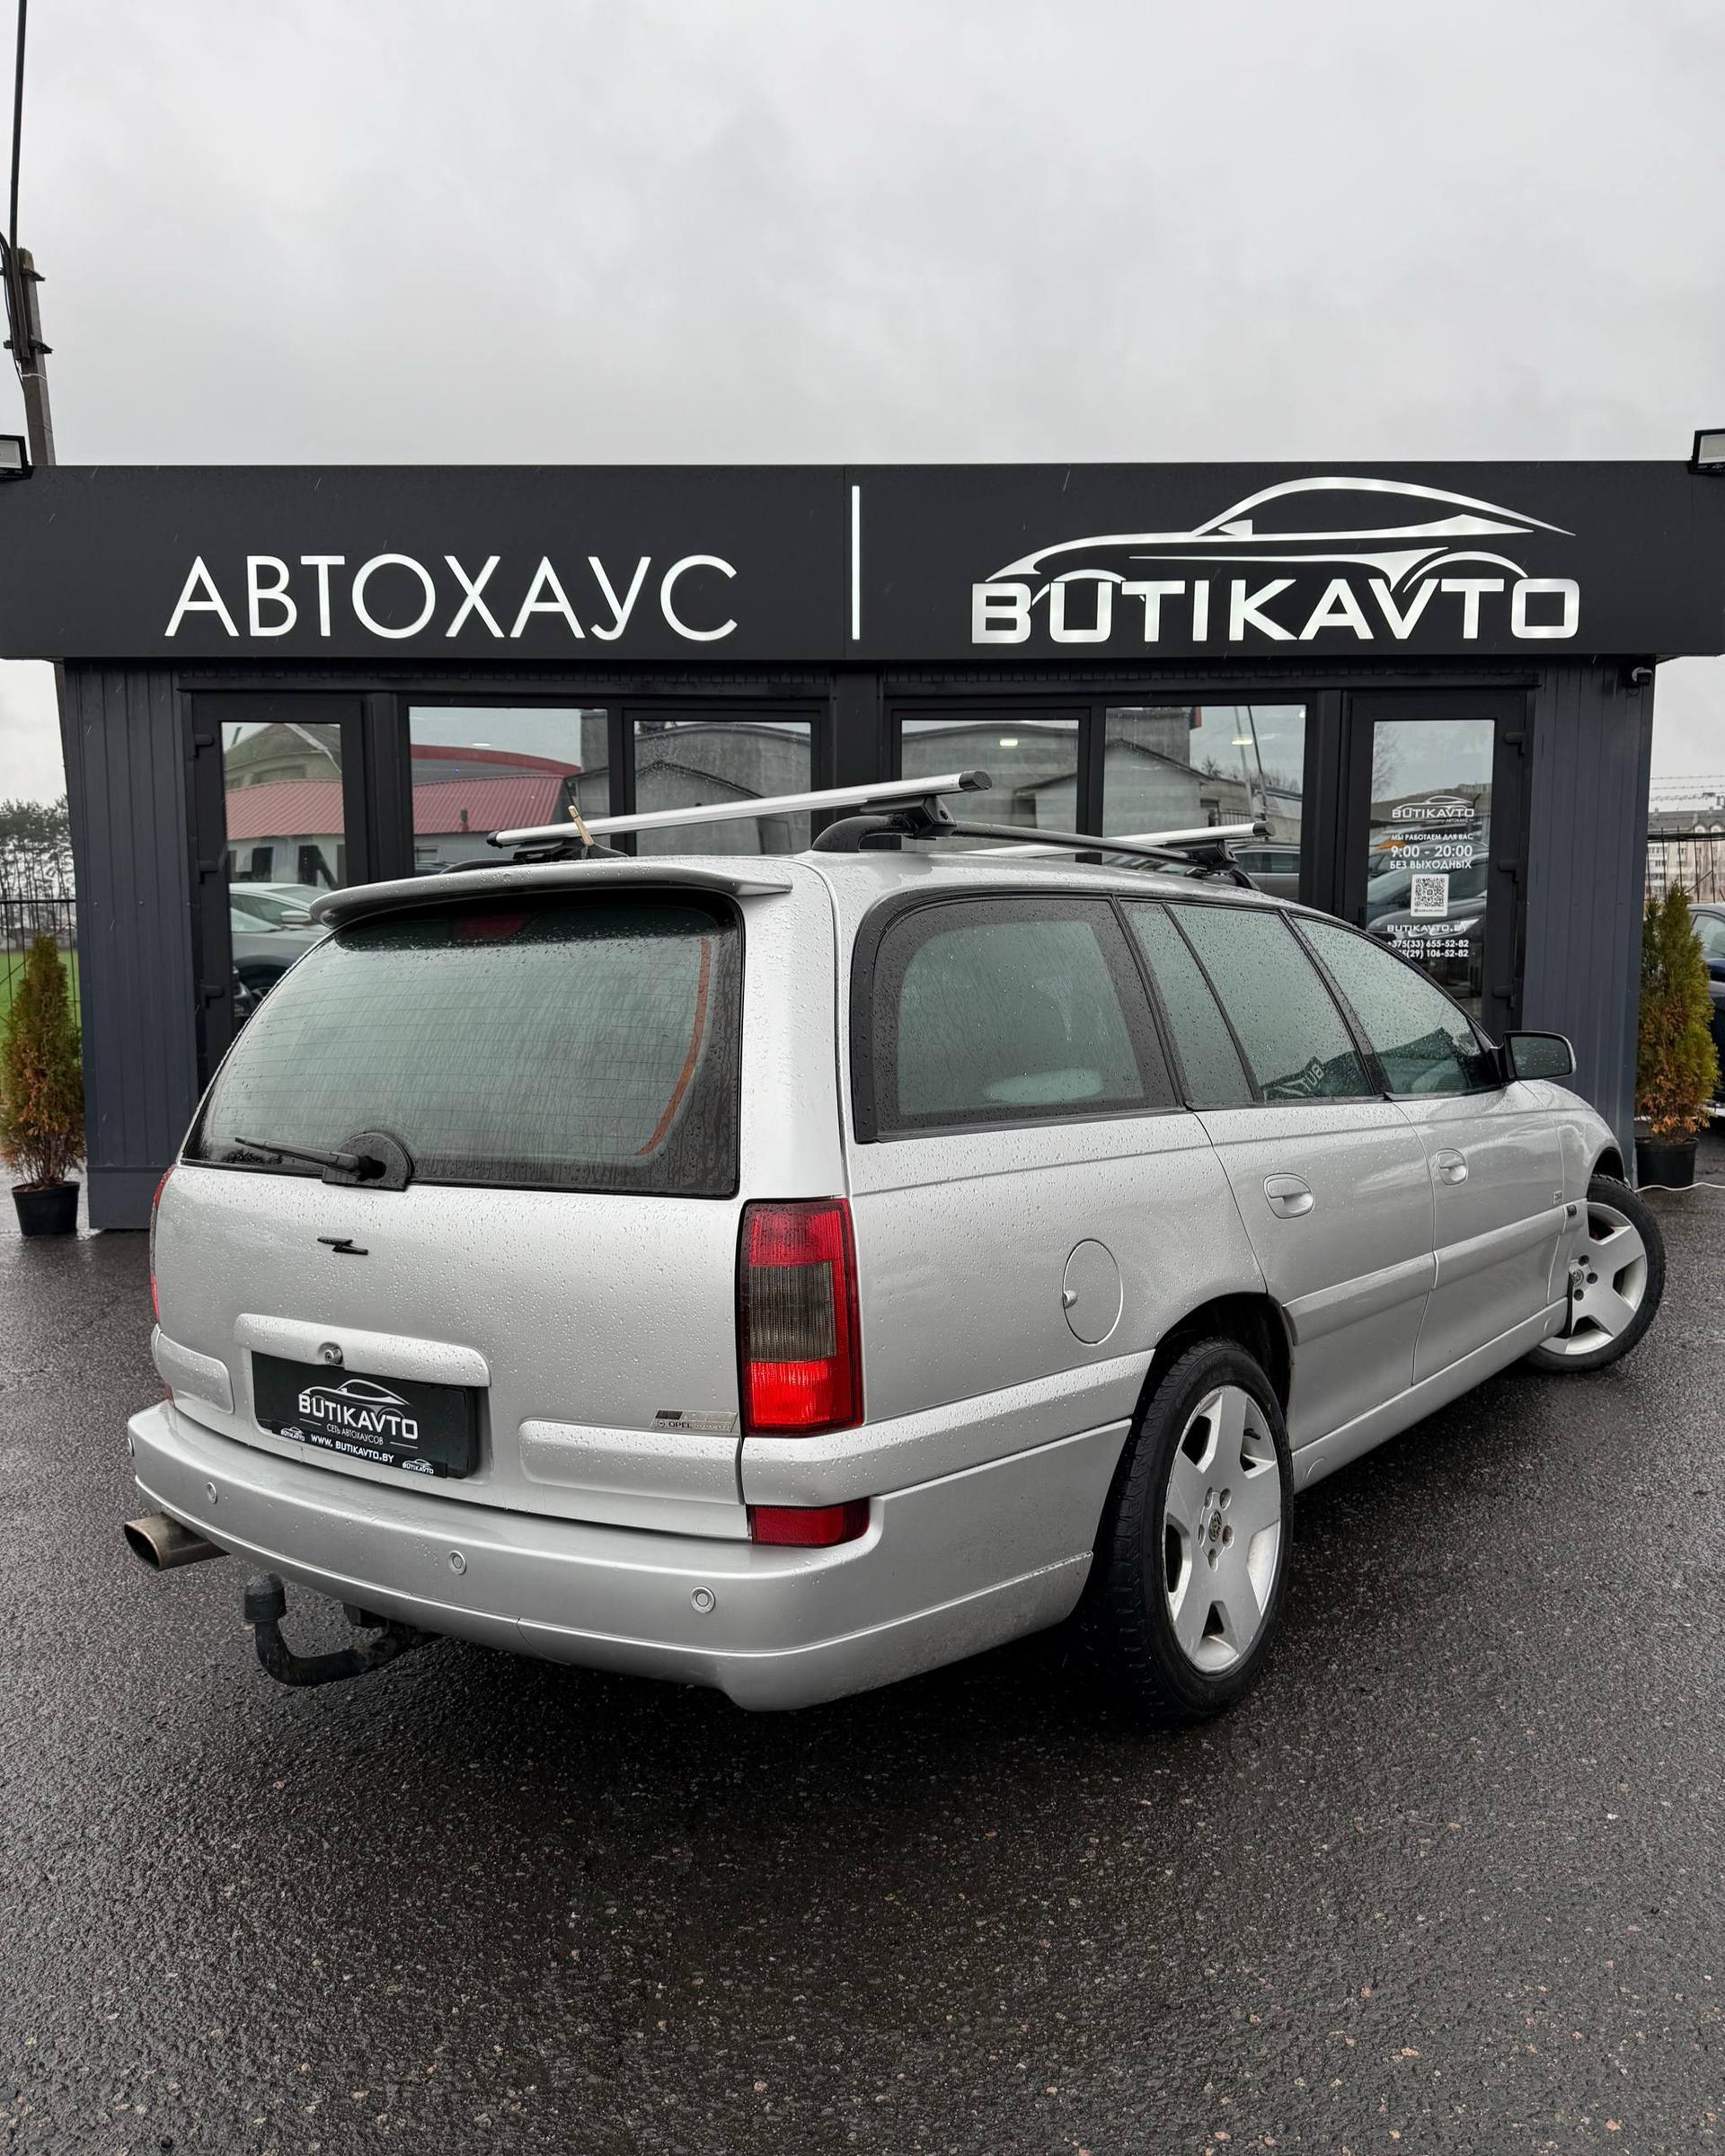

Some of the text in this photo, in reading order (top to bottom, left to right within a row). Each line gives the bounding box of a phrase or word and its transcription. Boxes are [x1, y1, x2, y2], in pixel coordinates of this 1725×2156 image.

[164, 553, 738, 641] АВТОХАУС
[971, 578, 1580, 643] BUTIKAVTO
[1392, 808, 1474, 818] BUTIKAVTO
[1391, 844, 1420, 857] 9:00
[1434, 844, 1473, 857] 20:00
[1390, 860, 1473, 870] БЕЗ ВЫХОДНЫХ
[1387, 940, 1469, 949] +375(33) 655-52-82
[1427, 950, 1469, 958] 106-52-82
[298, 1393, 419, 1440] BUTIKAVTO
[668, 1420, 693, 1429] OPEL
[327, 1424, 384, 1445] СЕТЬ АВТОХАУСОВ
[311, 1434, 394, 1463] WWW. BUTIKAVTO.BY
